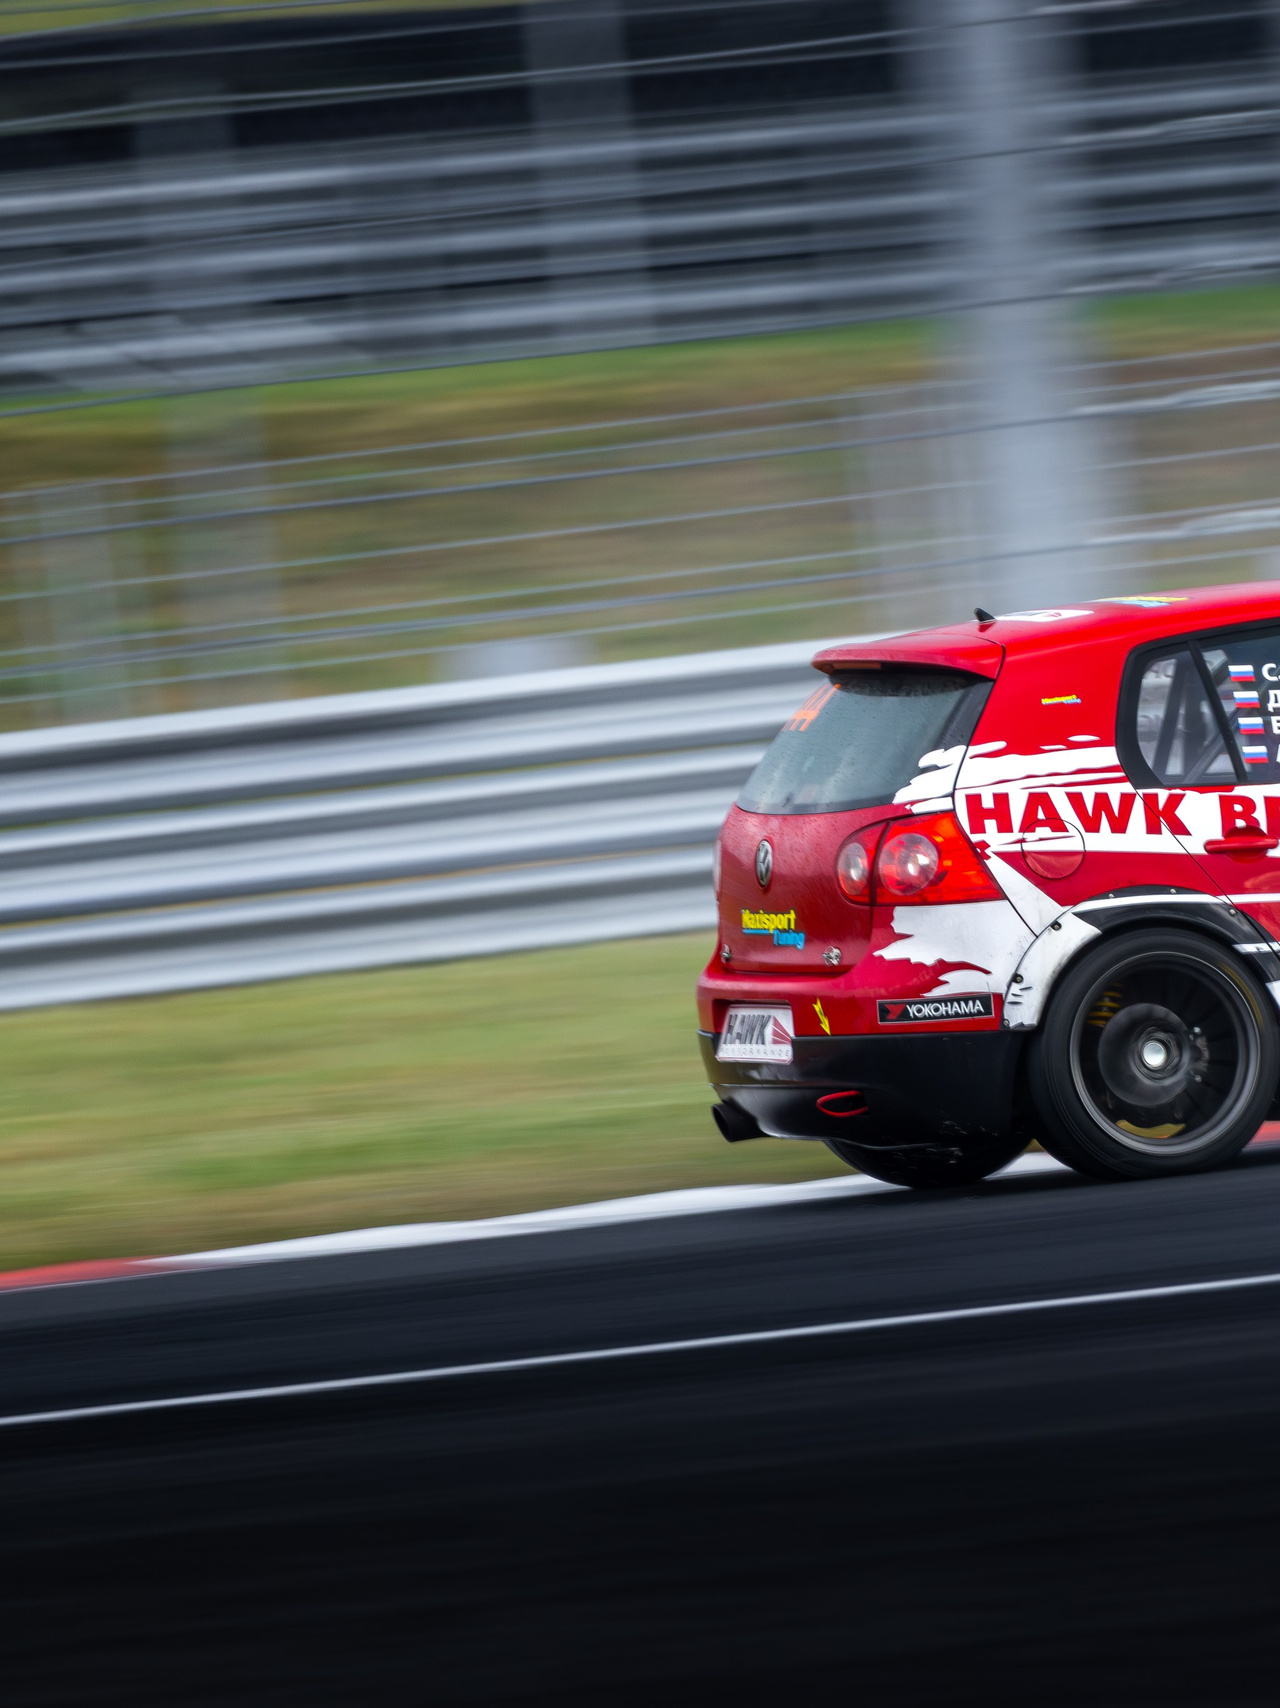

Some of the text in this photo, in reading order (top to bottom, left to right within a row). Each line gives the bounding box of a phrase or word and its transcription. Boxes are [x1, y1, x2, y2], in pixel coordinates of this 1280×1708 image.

[965, 791, 1193, 836] HAWK
[741, 909, 796, 934] Maxisport
[905, 1000, 985, 1019] YOKOHAMA
[722, 1013, 772, 1046] HAWK
